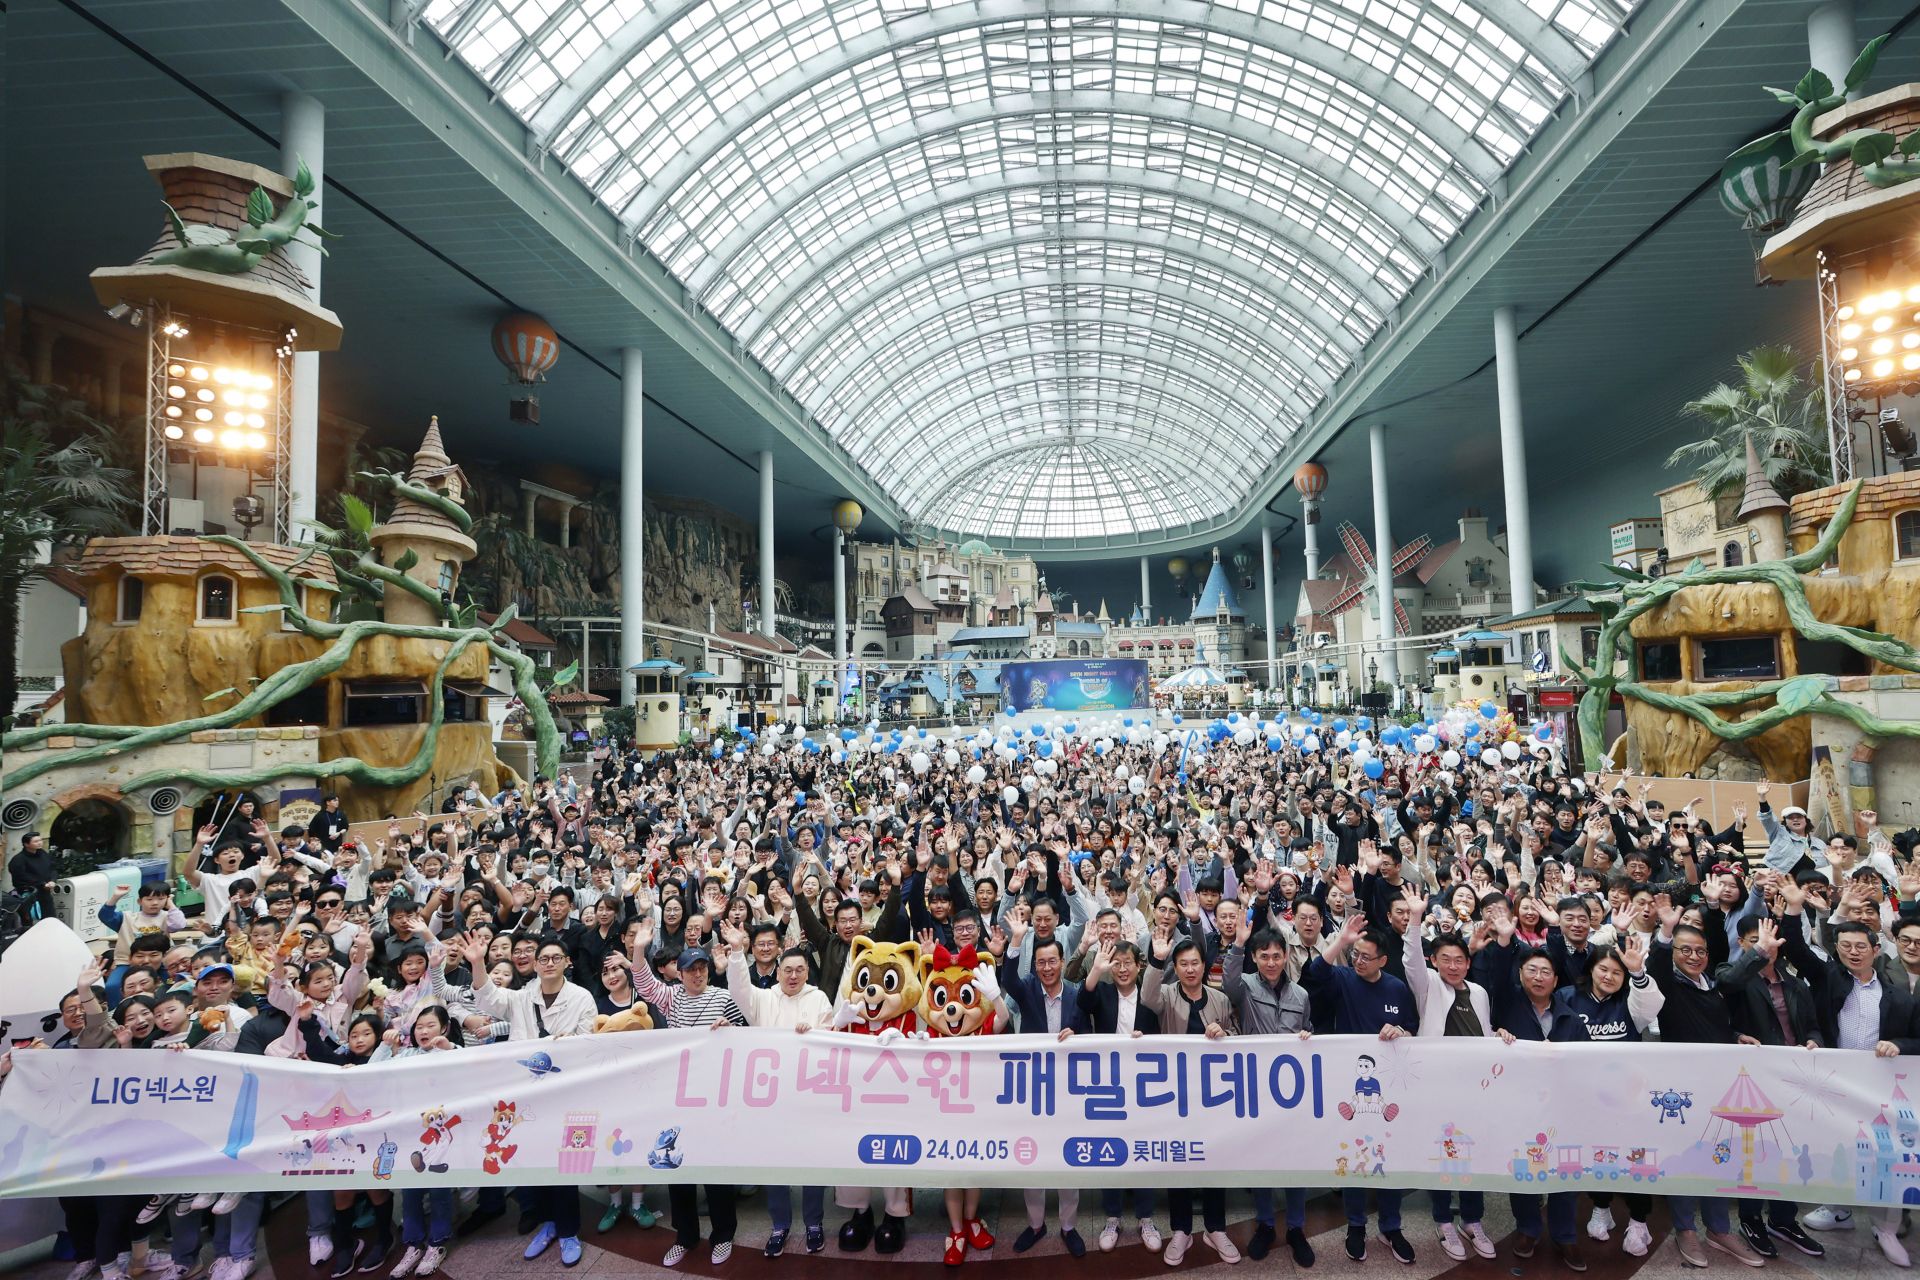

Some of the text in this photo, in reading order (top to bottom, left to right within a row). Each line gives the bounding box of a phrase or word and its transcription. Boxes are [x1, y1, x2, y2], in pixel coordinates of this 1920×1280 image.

[1384, 1004, 1399, 1014] LIG
[996, 1051, 1324, 1121] 패밀리데이
[926, 1139, 1009, 1160] 24.04.05
[1019, 1141, 1032, 1159] 금
[1133, 1140, 1206, 1162] 롯데월드
